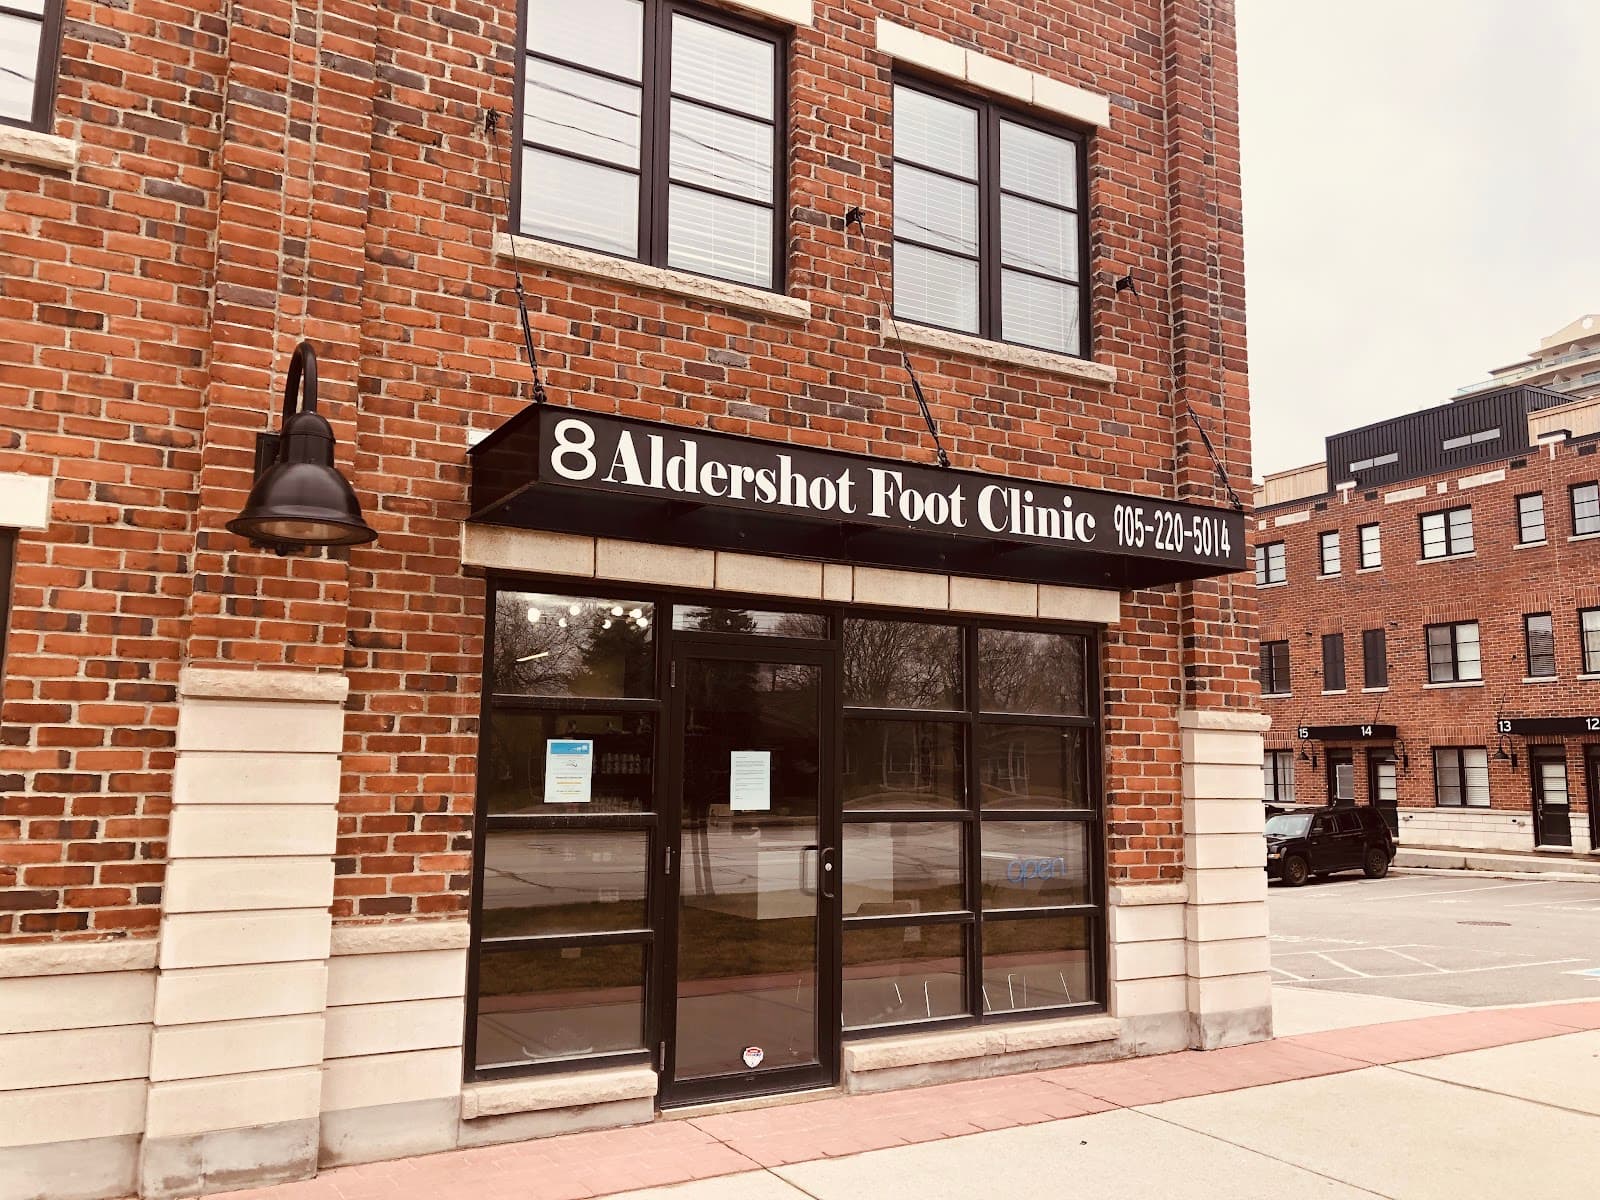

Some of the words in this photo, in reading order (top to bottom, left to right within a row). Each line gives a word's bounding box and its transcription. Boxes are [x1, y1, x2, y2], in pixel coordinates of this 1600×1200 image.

[550, 418, 597, 481] 8
[601, 430, 857, 514] Aldershot
[866, 467, 967, 528] Foot
[977, 484, 1097, 543] Clinic
[1113, 503, 1231, 558] 905-220-5014
[1498, 720, 1512, 732] 13
[1585, 717, 1600, 730] 12
[1299, 727, 1309, 738] 15
[1361, 725, 1373, 737] 14
